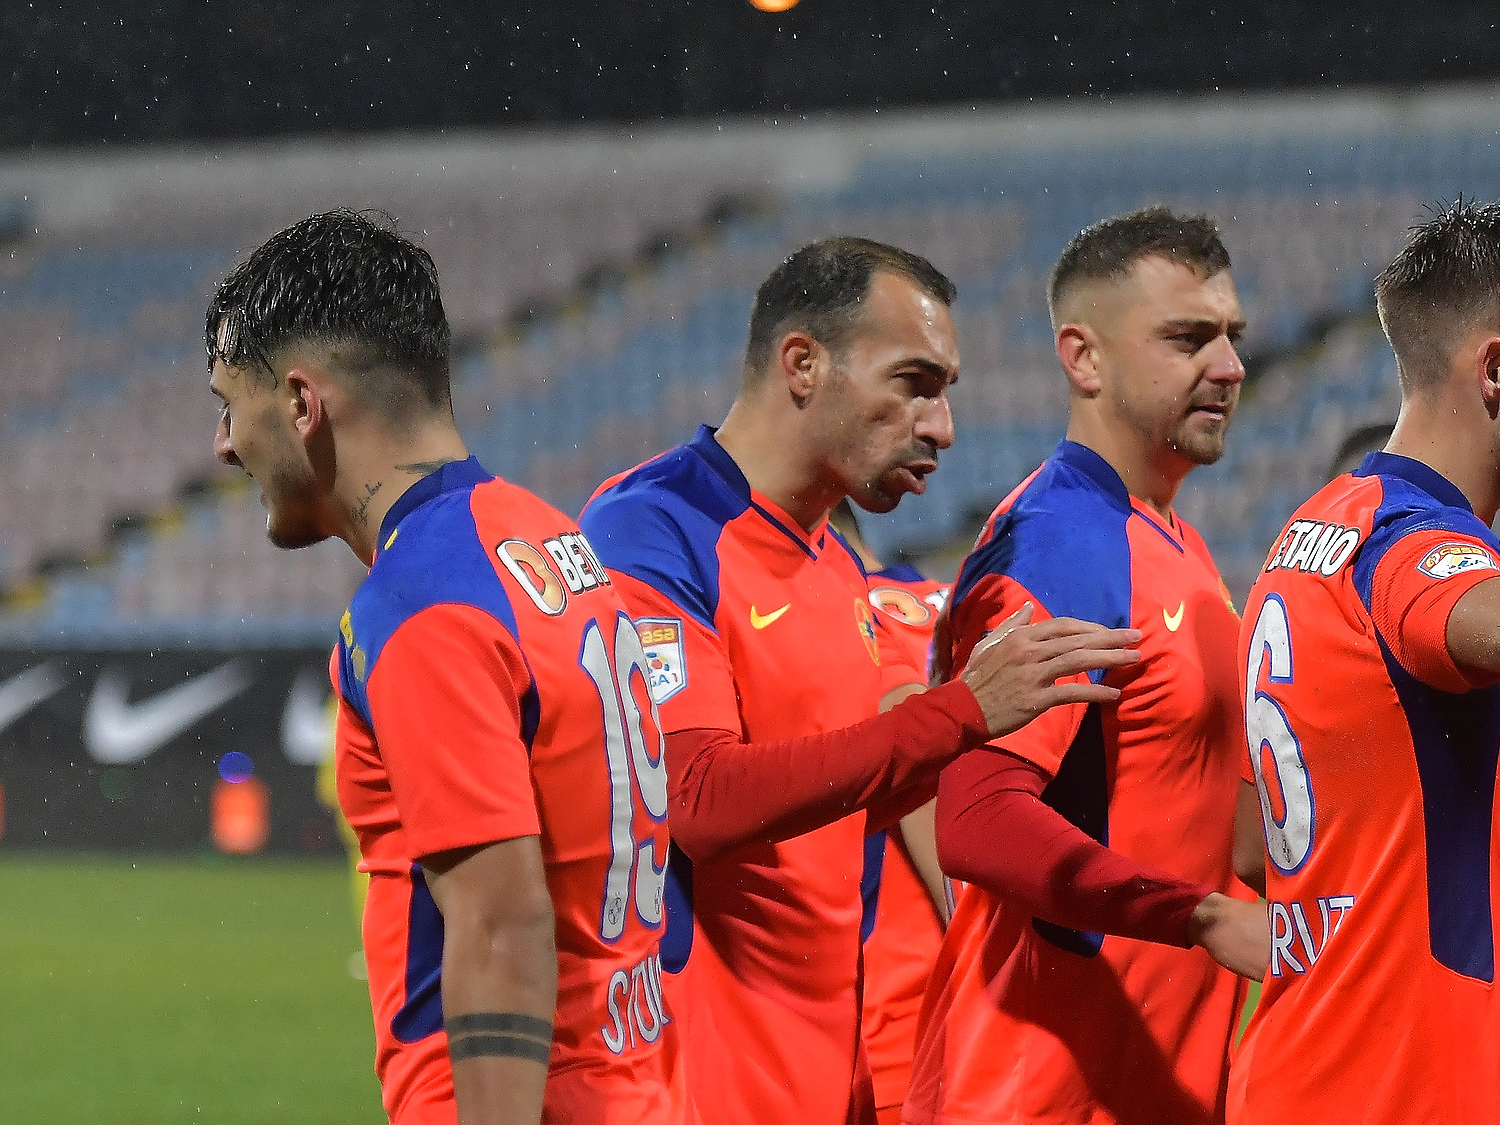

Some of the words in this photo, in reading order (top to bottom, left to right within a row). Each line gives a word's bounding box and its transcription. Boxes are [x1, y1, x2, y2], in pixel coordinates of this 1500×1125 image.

[641, 627, 676, 645] asa
[578, 610, 669, 945] 19
[1244, 592, 1317, 876] 6
[1267, 894, 1356, 979] RUT
